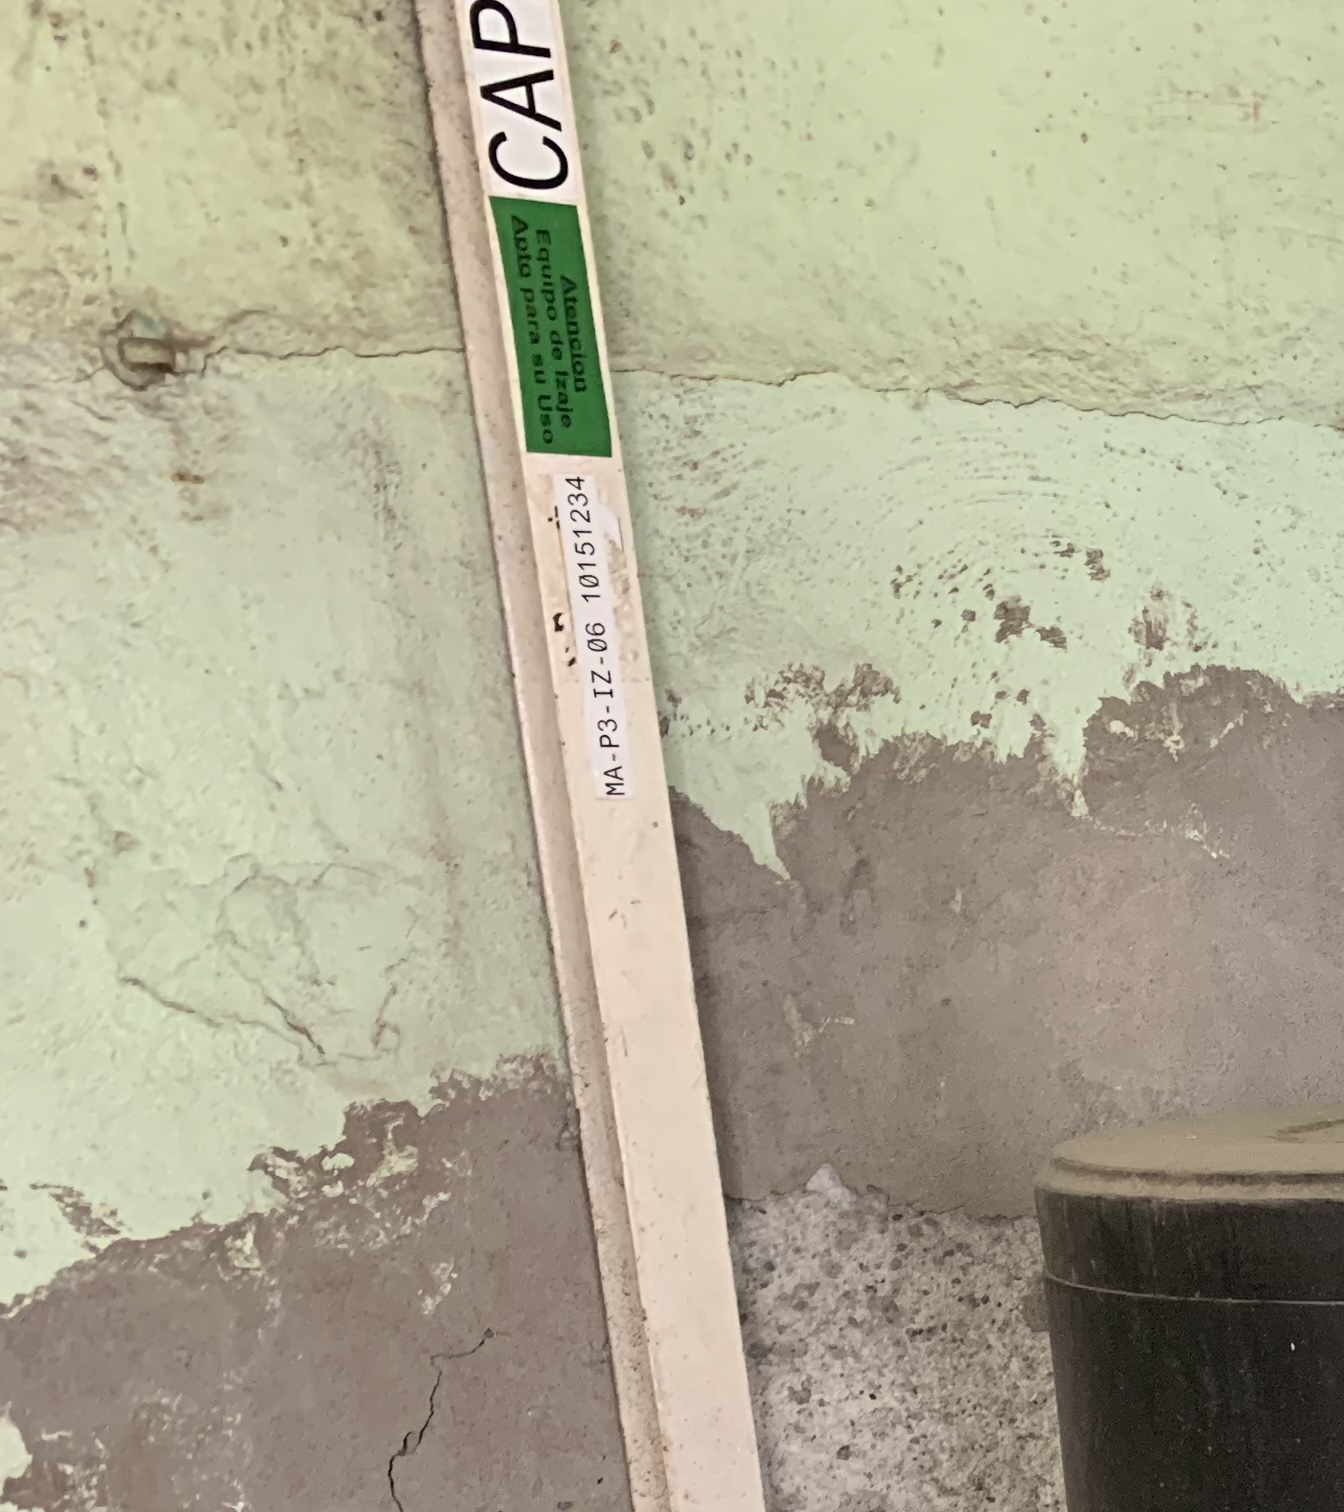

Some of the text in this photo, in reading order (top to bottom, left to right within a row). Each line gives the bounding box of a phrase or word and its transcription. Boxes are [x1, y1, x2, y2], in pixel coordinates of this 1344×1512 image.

[511, 214, 553, 444] Apto para su Uso
[536, 229, 574, 428] Equipo de Izaje
[560, 274, 587, 393] Atencion
[565, 475, 626, 796] MA-P3-IZ-06 10151234
